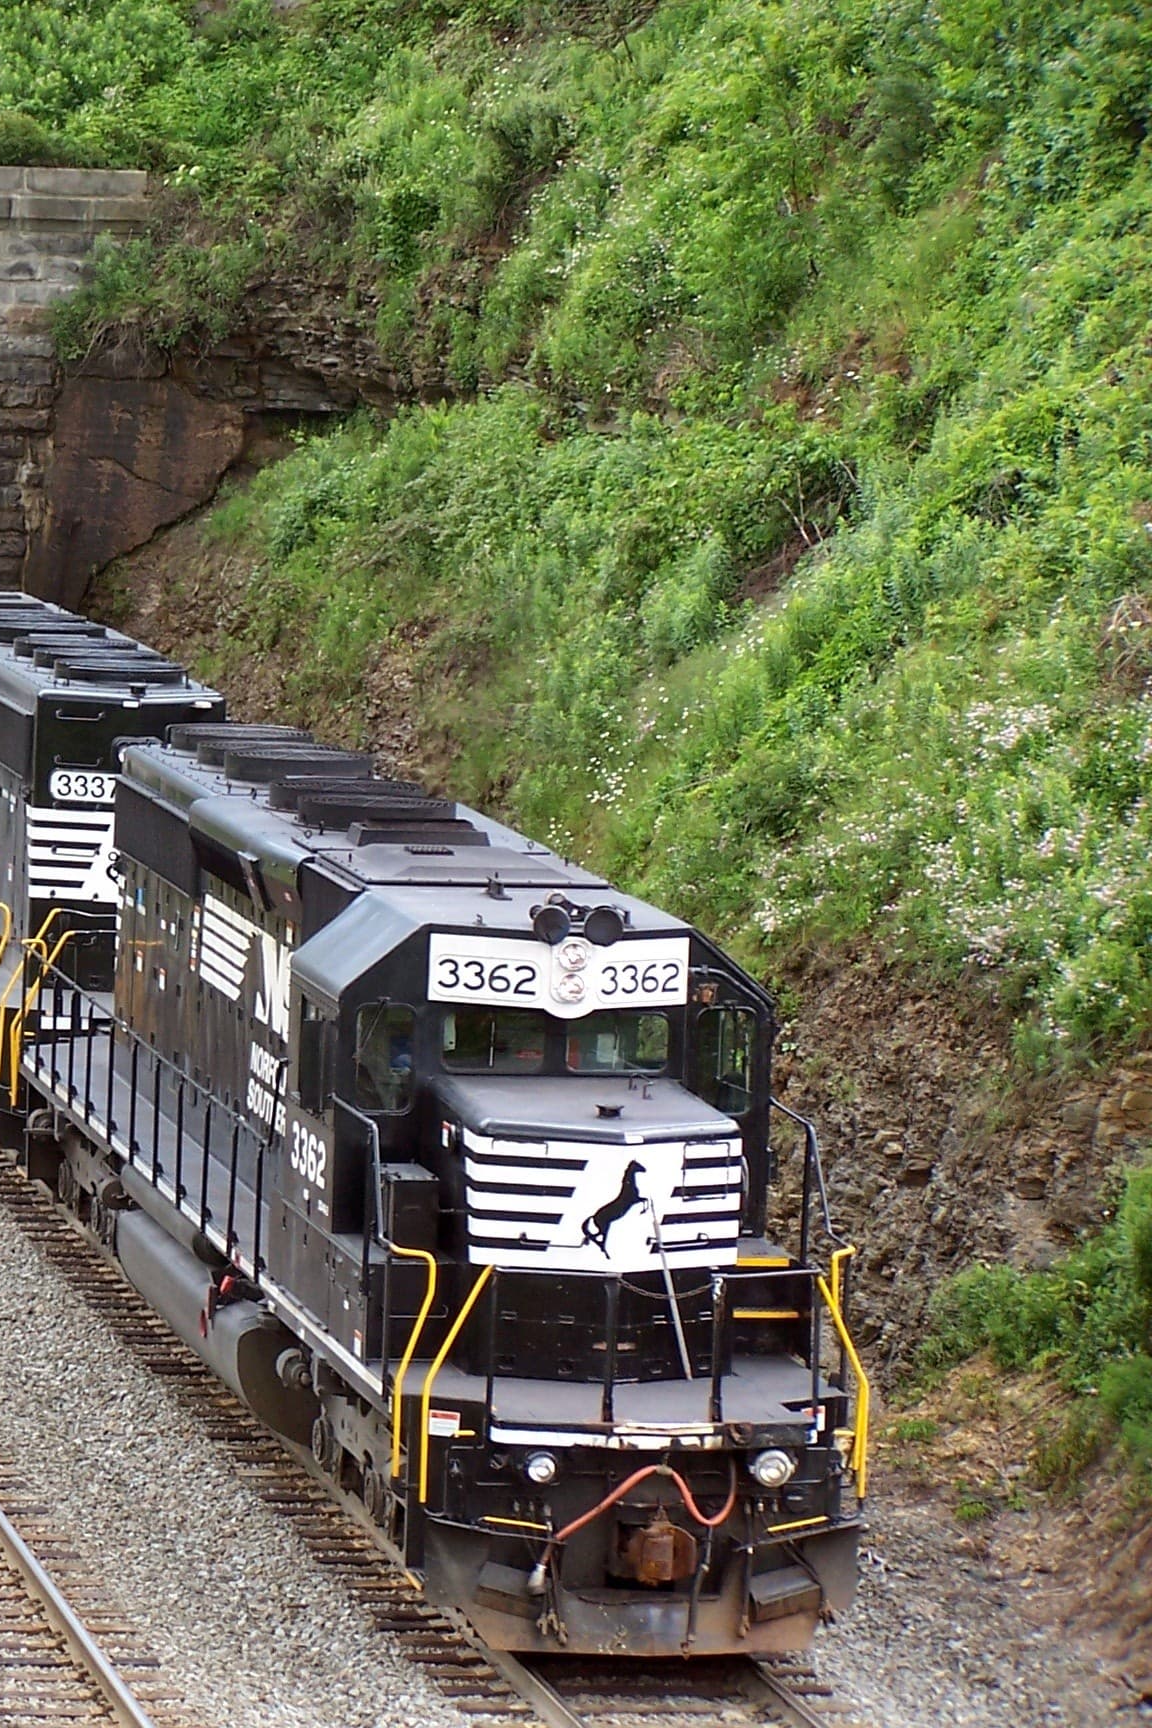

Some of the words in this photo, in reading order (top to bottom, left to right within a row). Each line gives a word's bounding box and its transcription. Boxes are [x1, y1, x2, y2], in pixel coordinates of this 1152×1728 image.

[56, 774, 116, 799] 3337
[437, 957, 537, 997] 3362
[600, 962, 680, 996] 3362
[291, 1120, 327, 1190] 3362
